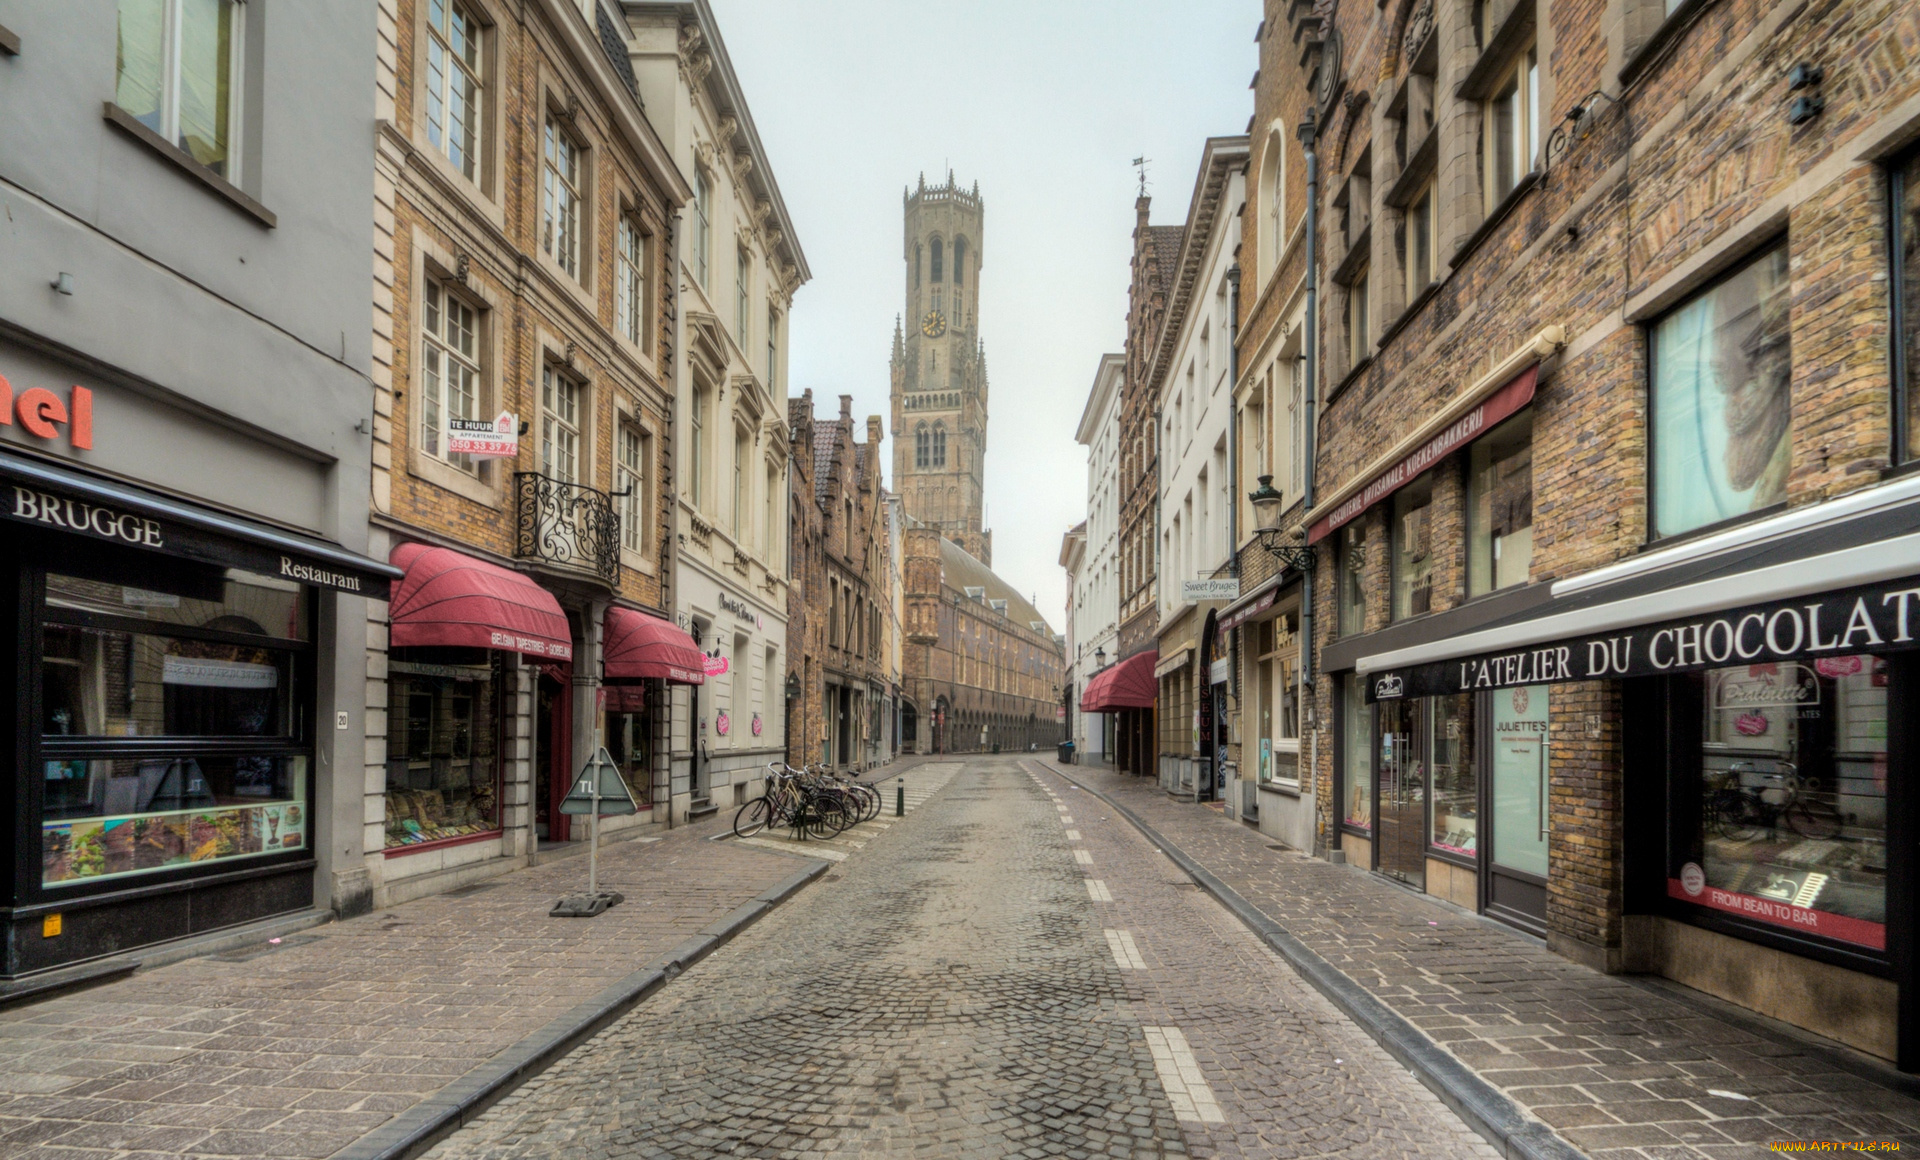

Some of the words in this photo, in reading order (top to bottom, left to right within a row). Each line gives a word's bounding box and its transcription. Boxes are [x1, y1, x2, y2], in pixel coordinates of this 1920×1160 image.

[0, 374, 93, 450] el
[451, 421, 462, 429] TE
[465, 422, 493, 431] HUUR
[451, 440, 470, 449] 050
[473, 441, 486, 450] 33
[489, 443, 501, 451] 39
[505, 443, 517, 452] 76
[460, 432, 503, 440] APPARTEMENT
[1329, 493, 1361, 528] BISCUITERIE
[1364, 468, 1404, 504] ARTISANALE
[1407, 406, 1483, 477] KOEKENBAKKERIJ
[12, 486, 163, 548] BRUGGE
[280, 556, 361, 591] Restaurant
[1184, 581, 1208, 592] Sweet
[1209, 580, 1238, 593] Bruges
[491, 632, 515, 648] BELGIAN
[516, 637, 545, 654] TAPESTRIES
[1459, 646, 1572, 690] L'ATELIER
[1586, 636, 1633, 676] DU
[1649, 587, 1920, 670] CHOCOLAT
[1200, 666, 1211, 741] MUSEUM
[338, 714, 347, 727] 20
[1496, 720, 1547, 732] JULIETTE'S
[1712, 890, 1741, 908] FROM
[1743, 898, 1773, 916] BEAN
[1775, 905, 1791, 920] TO
[1793, 909, 1818, 927] BAR
